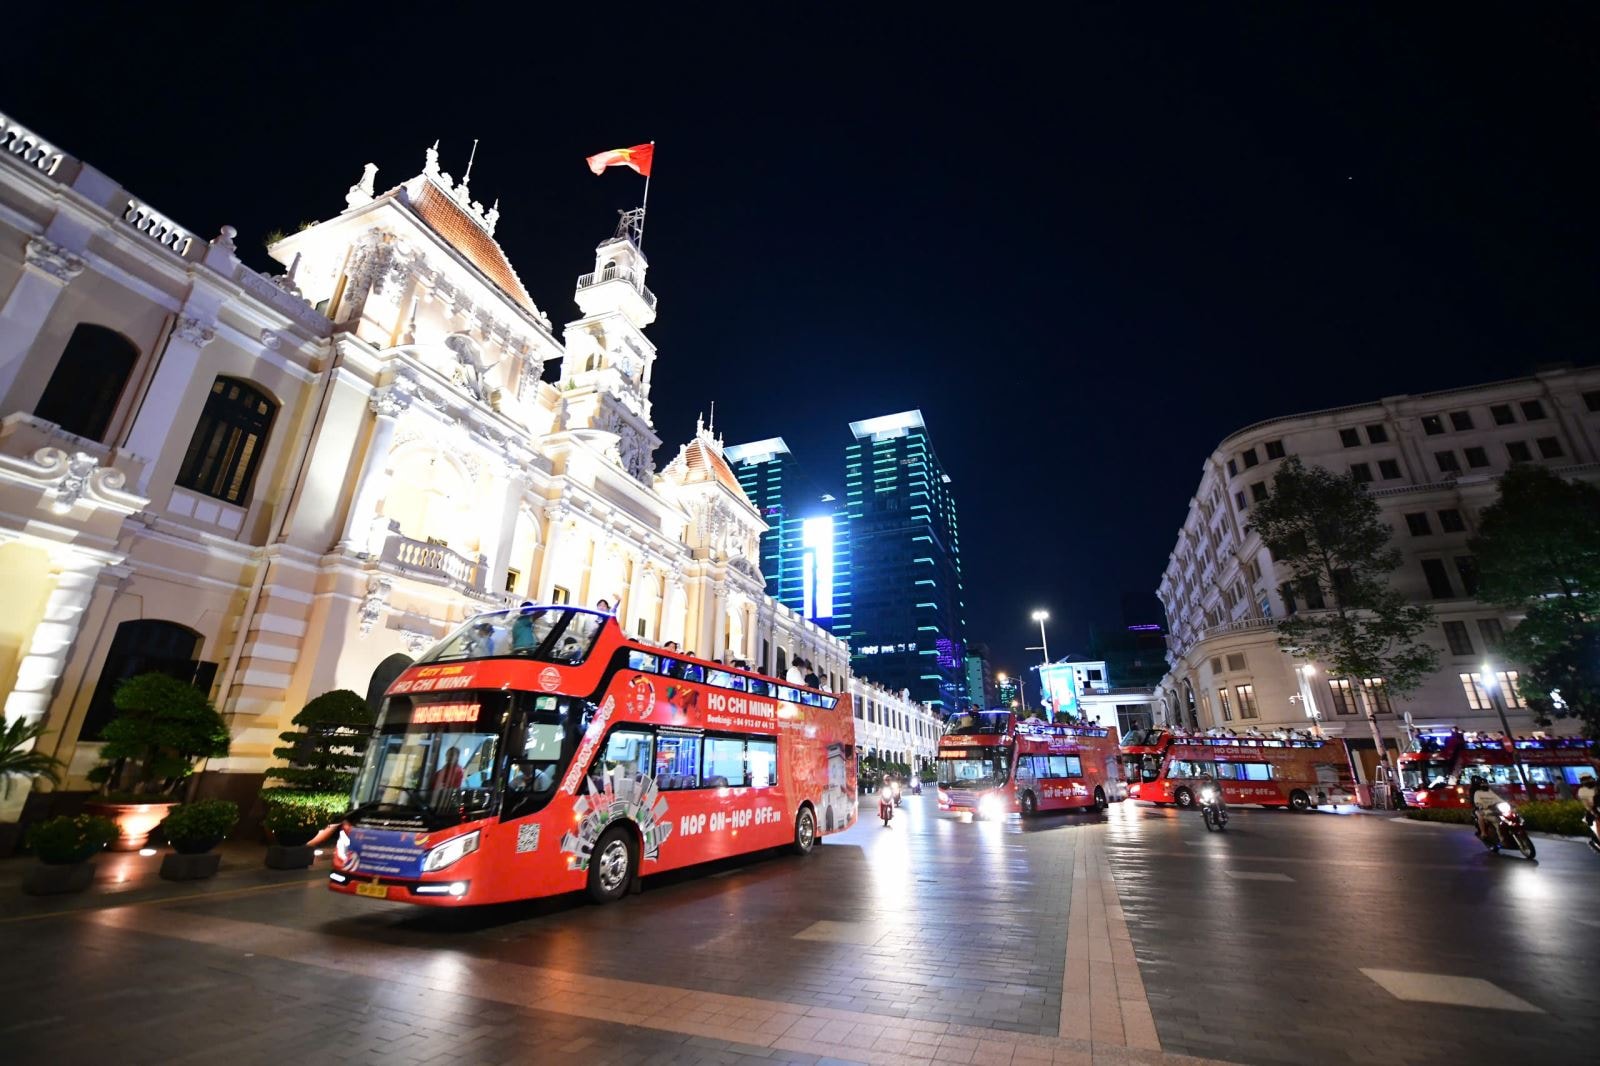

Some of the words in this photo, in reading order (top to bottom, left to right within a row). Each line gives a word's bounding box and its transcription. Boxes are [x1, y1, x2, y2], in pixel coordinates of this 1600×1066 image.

[393, 681, 413, 693] HO
[412, 678, 437, 692] CHI
[434, 675, 474, 690] MINH
[708, 693, 725, 711] HO
[728, 696, 747, 715] CHI
[749, 700, 775, 719] MINH
[681, 813, 706, 836] HOP
[710, 808, 753, 832] ON-HOP
